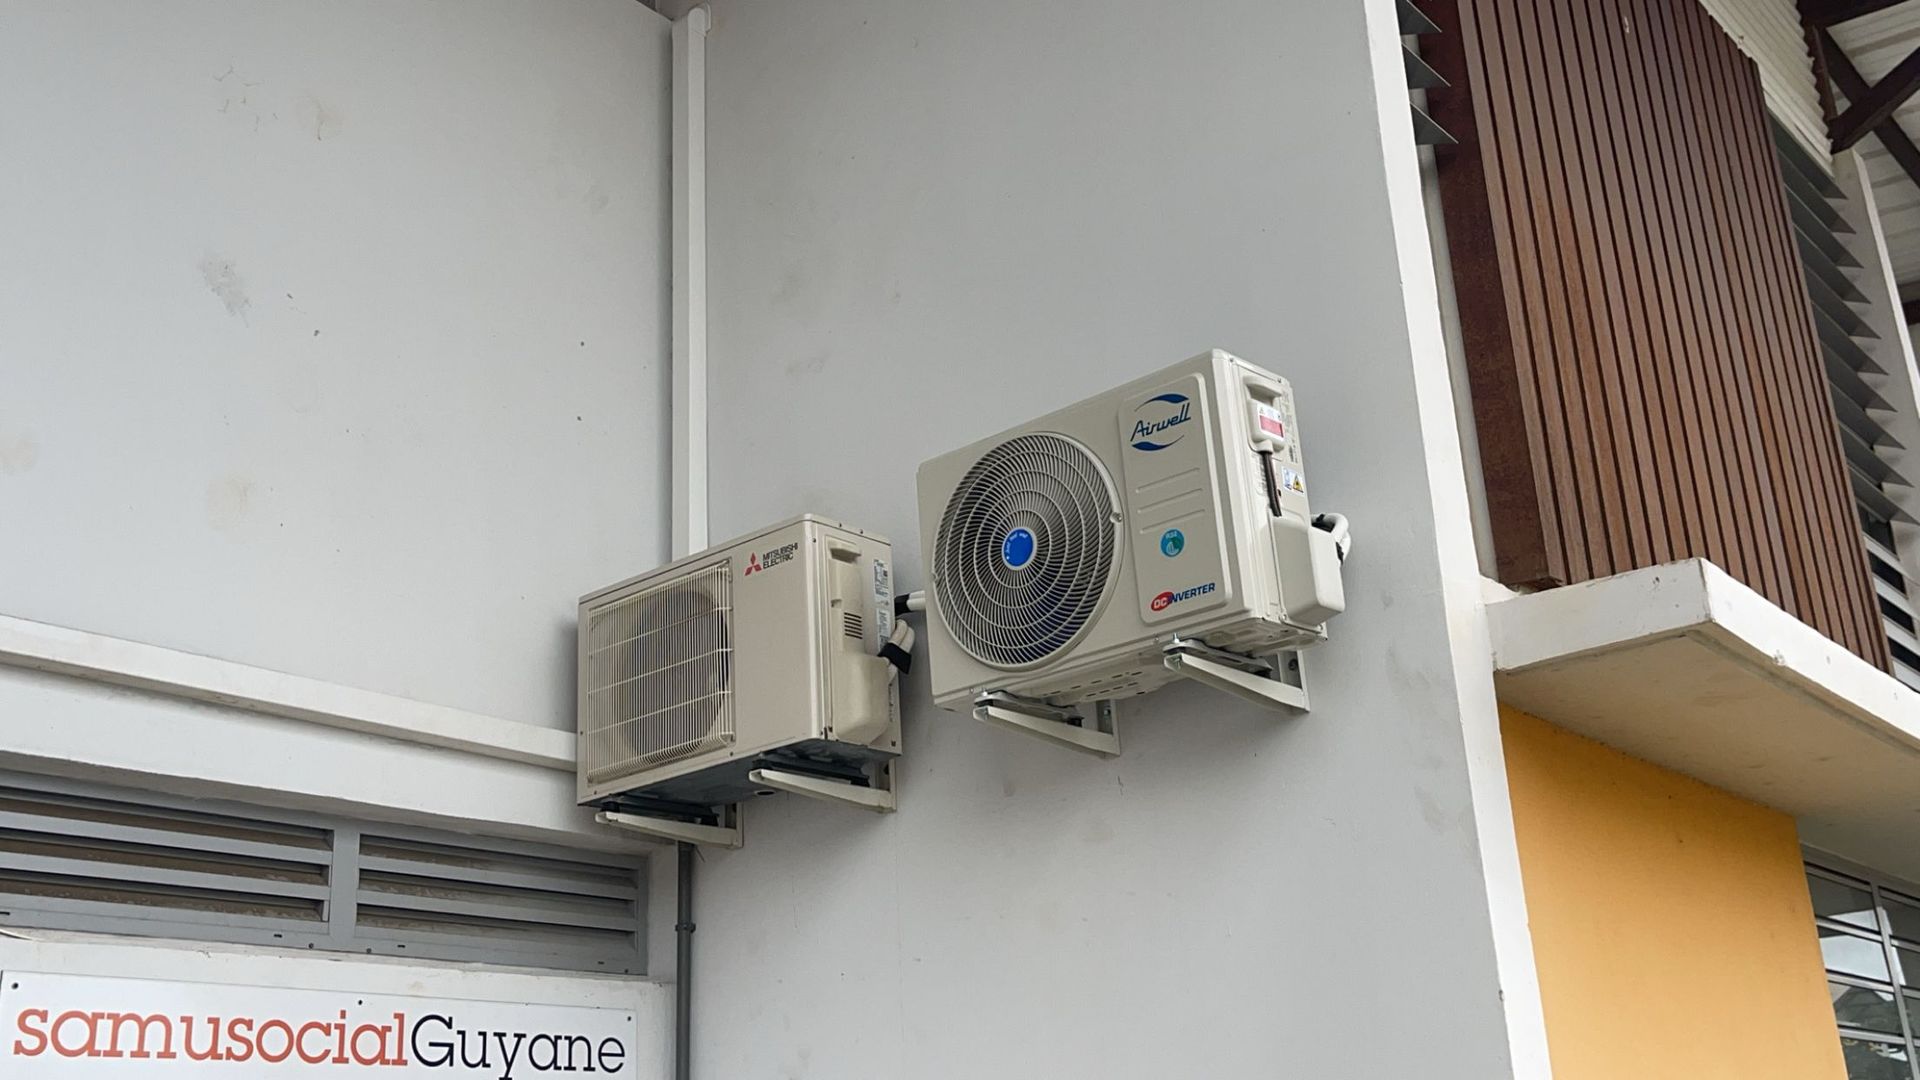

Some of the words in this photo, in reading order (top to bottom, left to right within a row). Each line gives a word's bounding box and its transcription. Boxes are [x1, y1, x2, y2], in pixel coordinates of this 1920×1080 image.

[1130, 402, 1191, 442] Airwell
[762, 542, 799, 561] MITSUBISHI
[762, 551, 794, 570] ELECTRIC
[1153, 596, 1169, 610] DC
[13, 1007, 626, 1080] samusocialGuyane
